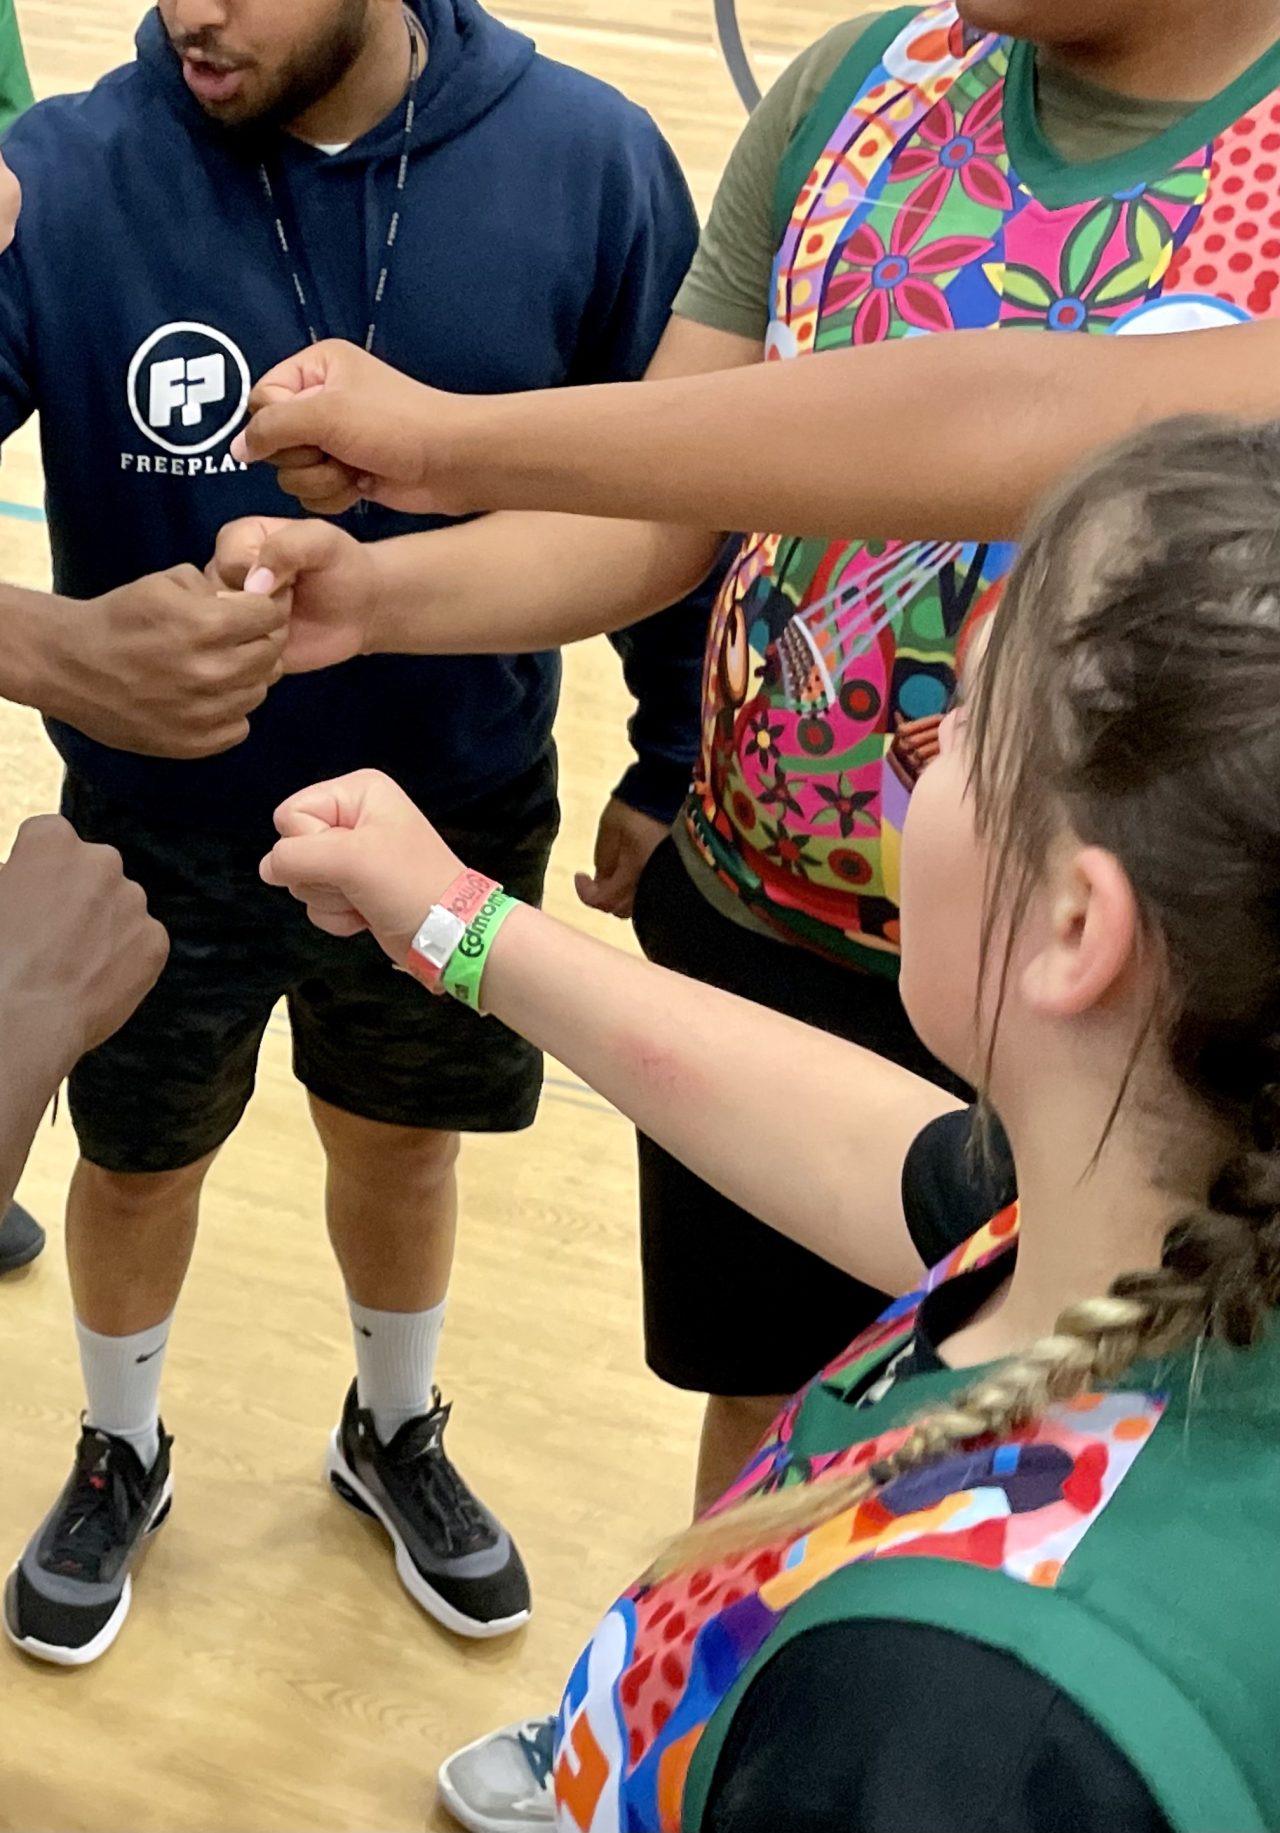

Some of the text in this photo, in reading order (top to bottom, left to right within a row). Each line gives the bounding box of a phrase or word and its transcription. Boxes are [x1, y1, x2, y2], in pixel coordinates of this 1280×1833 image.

[149, 353, 225, 427] FP
[120, 452, 248, 476] FREEPLA
[458, 888, 508, 958] Edmon
